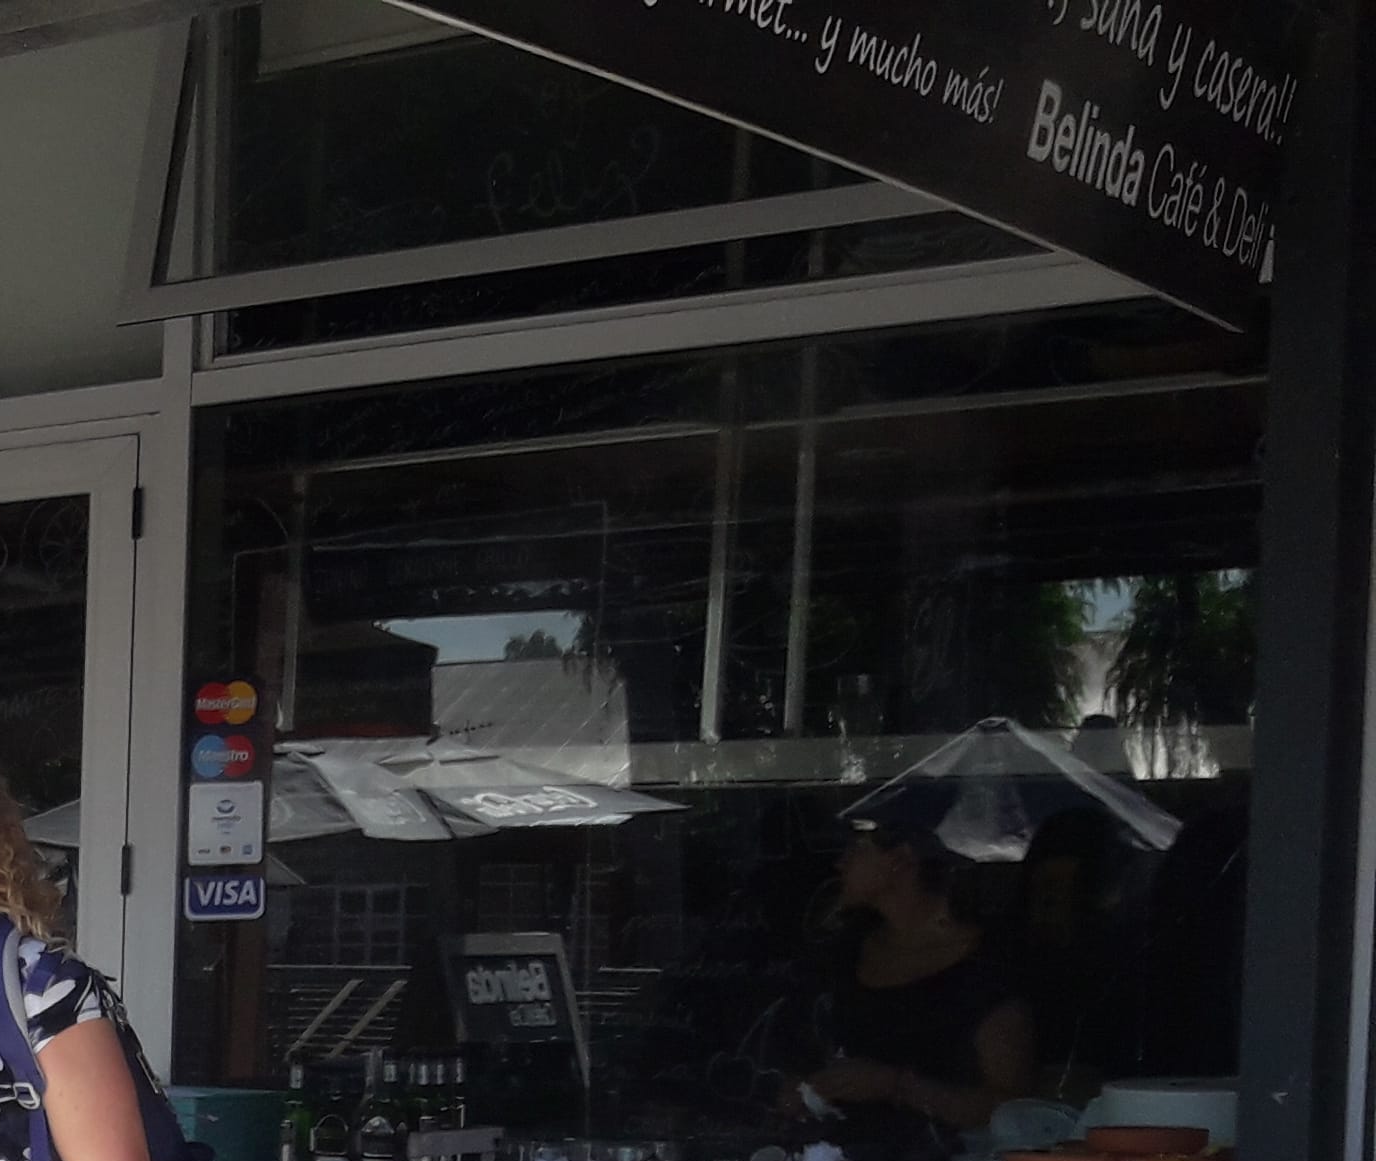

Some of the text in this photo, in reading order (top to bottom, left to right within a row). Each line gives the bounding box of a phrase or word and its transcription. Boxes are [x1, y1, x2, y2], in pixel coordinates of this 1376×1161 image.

[814, 16, 842, 74] y
[847, 25, 938, 97] mucho
[942, 65, 1004, 124] más!
[1159, 22, 1193, 110] y
[1194, 39, 1298, 146] casera!!
[1026, 78, 1270, 269] Belinda Café & Deli
[194, 879, 259, 908] VISA
